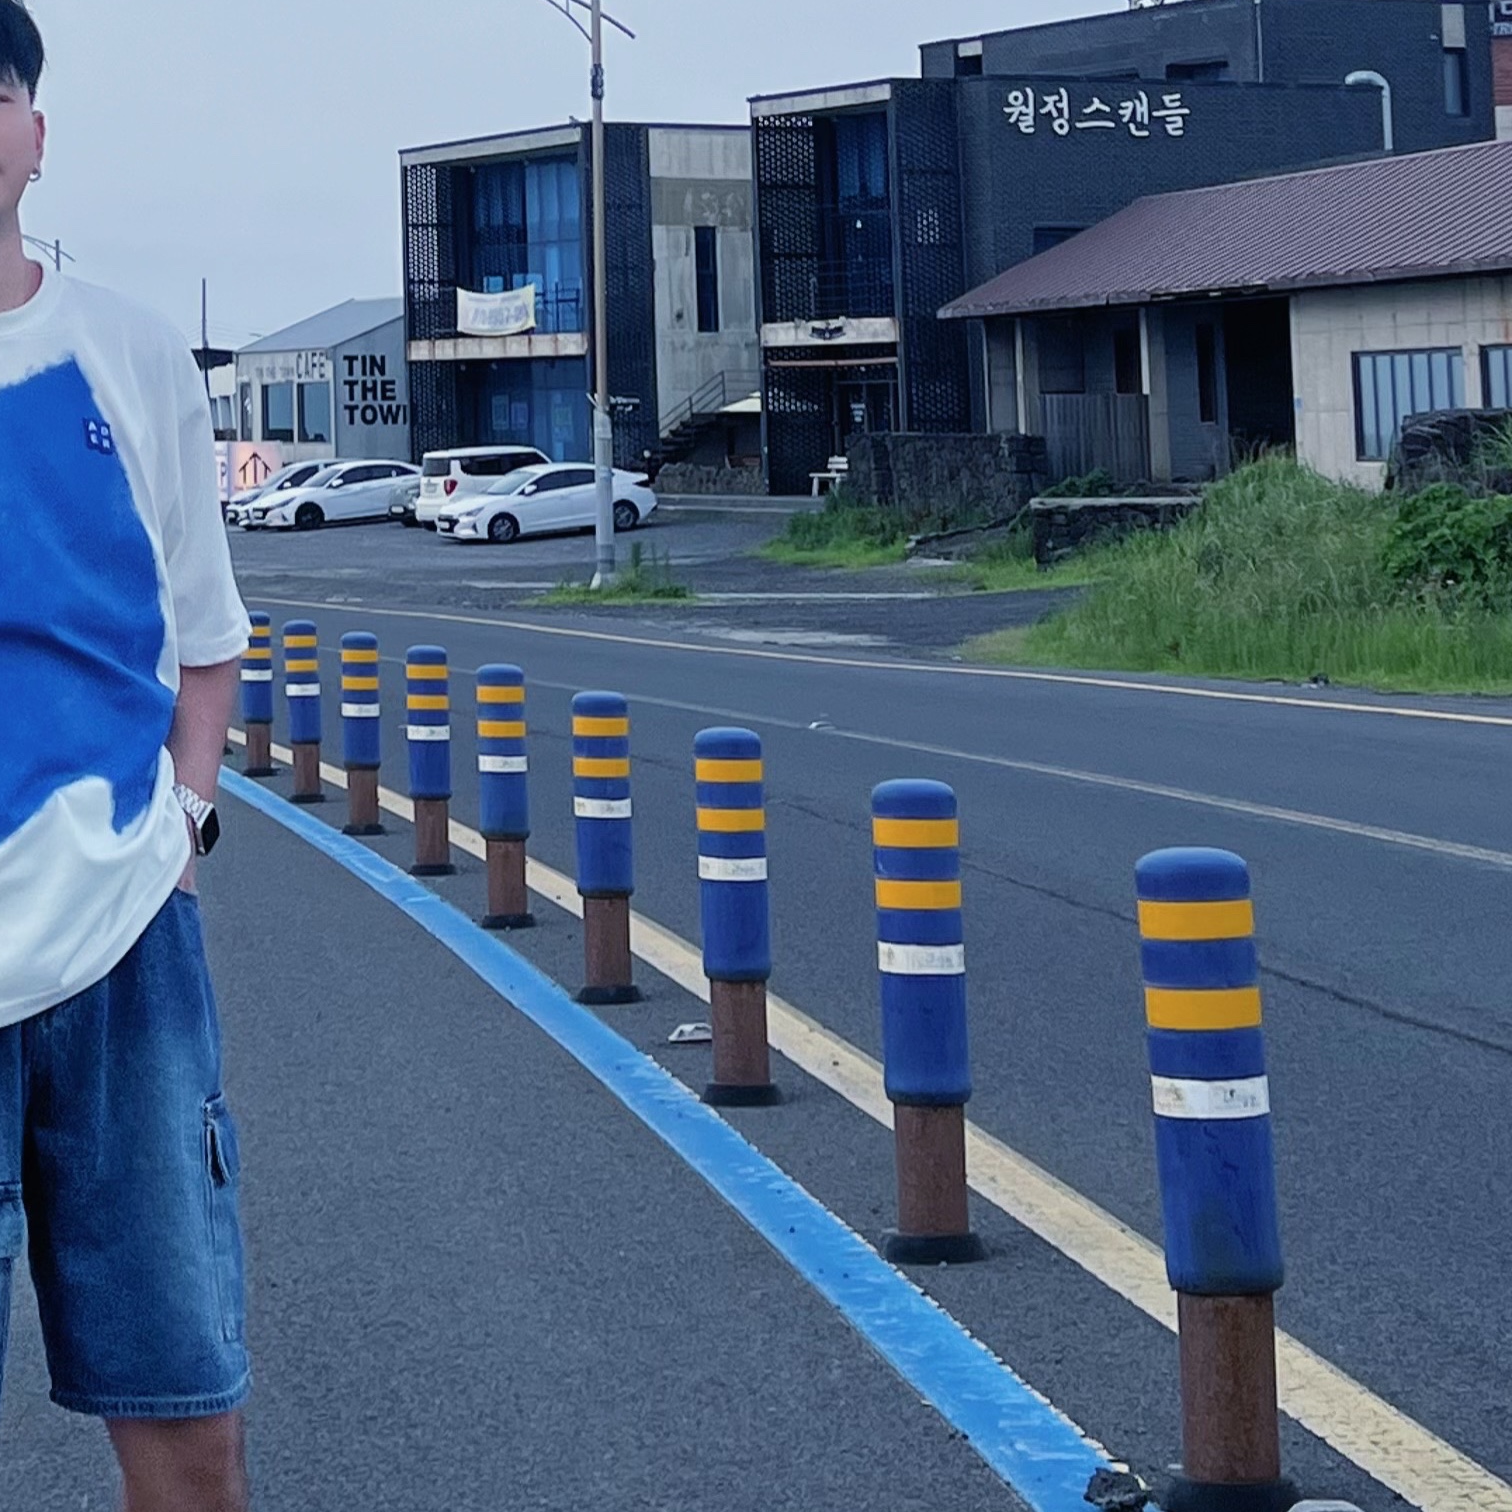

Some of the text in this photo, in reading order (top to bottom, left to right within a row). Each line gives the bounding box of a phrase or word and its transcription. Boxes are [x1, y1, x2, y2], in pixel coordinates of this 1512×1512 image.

[1003, 88, 1190, 136] 월정스캔들
[296, 352, 326, 379] CAFE
[343, 355, 386, 376] TIN
[343, 379, 397, 401] THE
[344, 404, 407, 426] TOW
